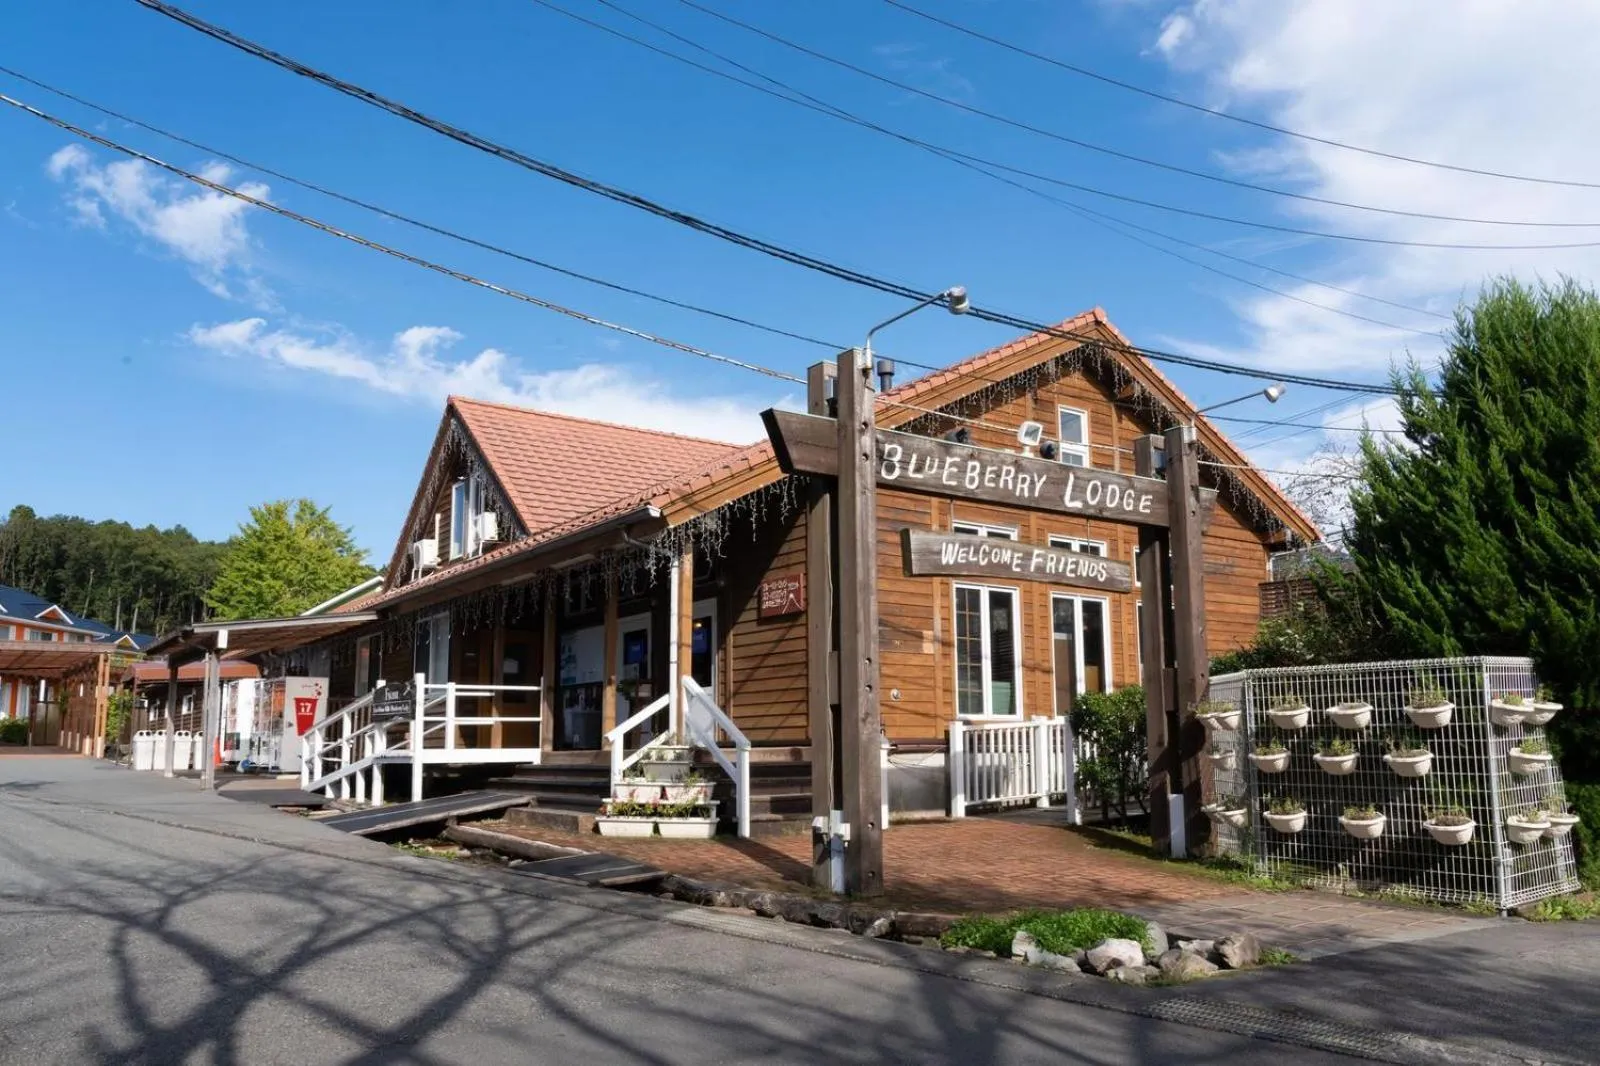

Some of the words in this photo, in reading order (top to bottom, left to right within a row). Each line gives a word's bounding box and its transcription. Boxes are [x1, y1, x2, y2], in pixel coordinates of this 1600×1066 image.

[880, 443, 1047, 498] BLUEBERRY
[1063, 472, 1153, 513] LODGE
[941, 541, 1023, 572] WELCOME
[1030, 549, 1107, 582] FRIENDS
